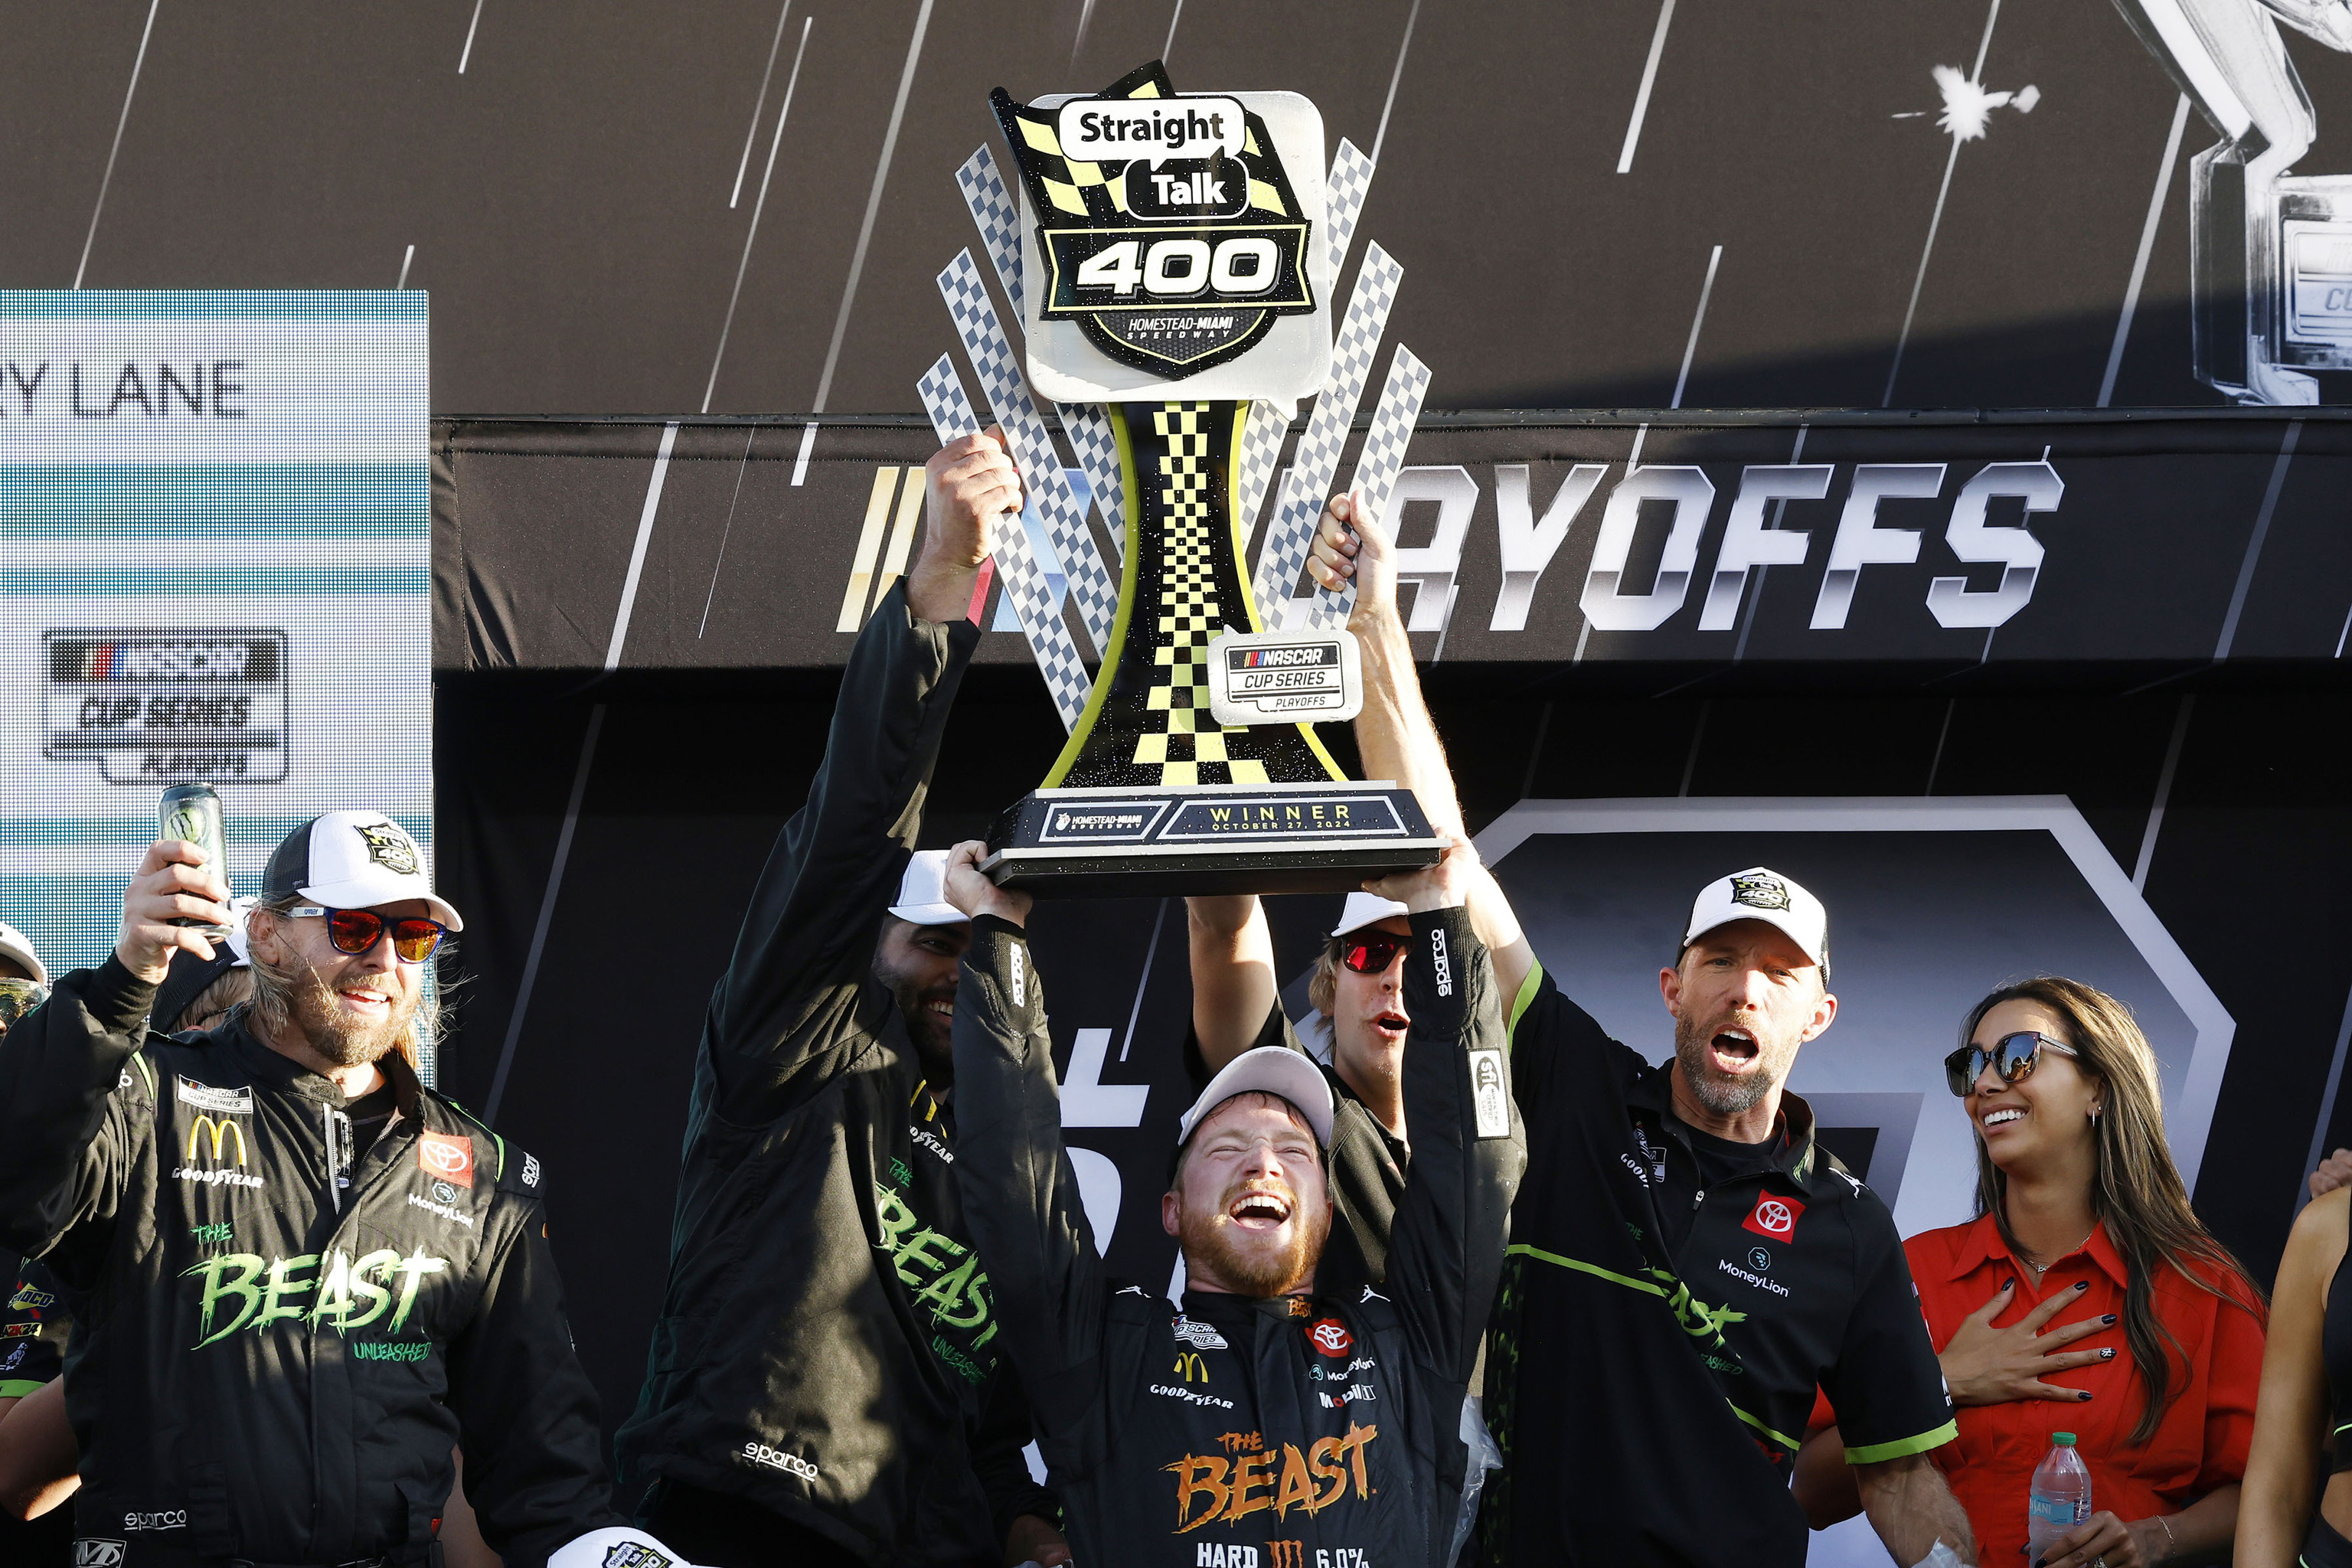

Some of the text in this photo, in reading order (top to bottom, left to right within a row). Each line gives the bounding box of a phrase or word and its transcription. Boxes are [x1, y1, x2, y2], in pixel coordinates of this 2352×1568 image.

[1080, 109, 1224, 149] Straight
[1151, 172, 1228, 205] Talk
[1076, 239, 1279, 296] 400
[1129, 316, 1233, 331] HOMESTEAD-MIAMI
[1127, 330, 1230, 340] SPEEDWAY
[0, 361, 247, 419] Y LANE
[1263, 648, 1323, 666] NASCAR
[1245, 671, 1325, 688] CUP SERIES
[1276, 697, 1325, 707] PLAYOFFS
[1072, 815, 1142, 825] HOMESTEAD-MIAMI
[1210, 805, 1350, 822] WINNER
[1212, 821, 1351, 831] OCTOBER 27, 2024
[1740, 890, 1783, 903] 400
[1431, 928, 1452, 997] sparco
[188, 1091, 241, 1108] CUP SERIES
[172, 1168, 263, 1188] GOODYEAR
[190, 1221, 234, 1245] THE
[1719, 1259, 1790, 1298] MoneyLion
[177, 1244, 451, 1351] BEAST
[354, 1341, 433, 1362] UNLEASHED
[1150, 1384, 1234, 1409] GOODYEAR
[1215, 1429, 1263, 1454] THE
[742, 1442, 818, 1482] sparco
[1158, 1419, 1378, 1534] BEAST
[124, 1510, 187, 1531] sparco
[1197, 1542, 1371, 1568] HARD 6.0%
